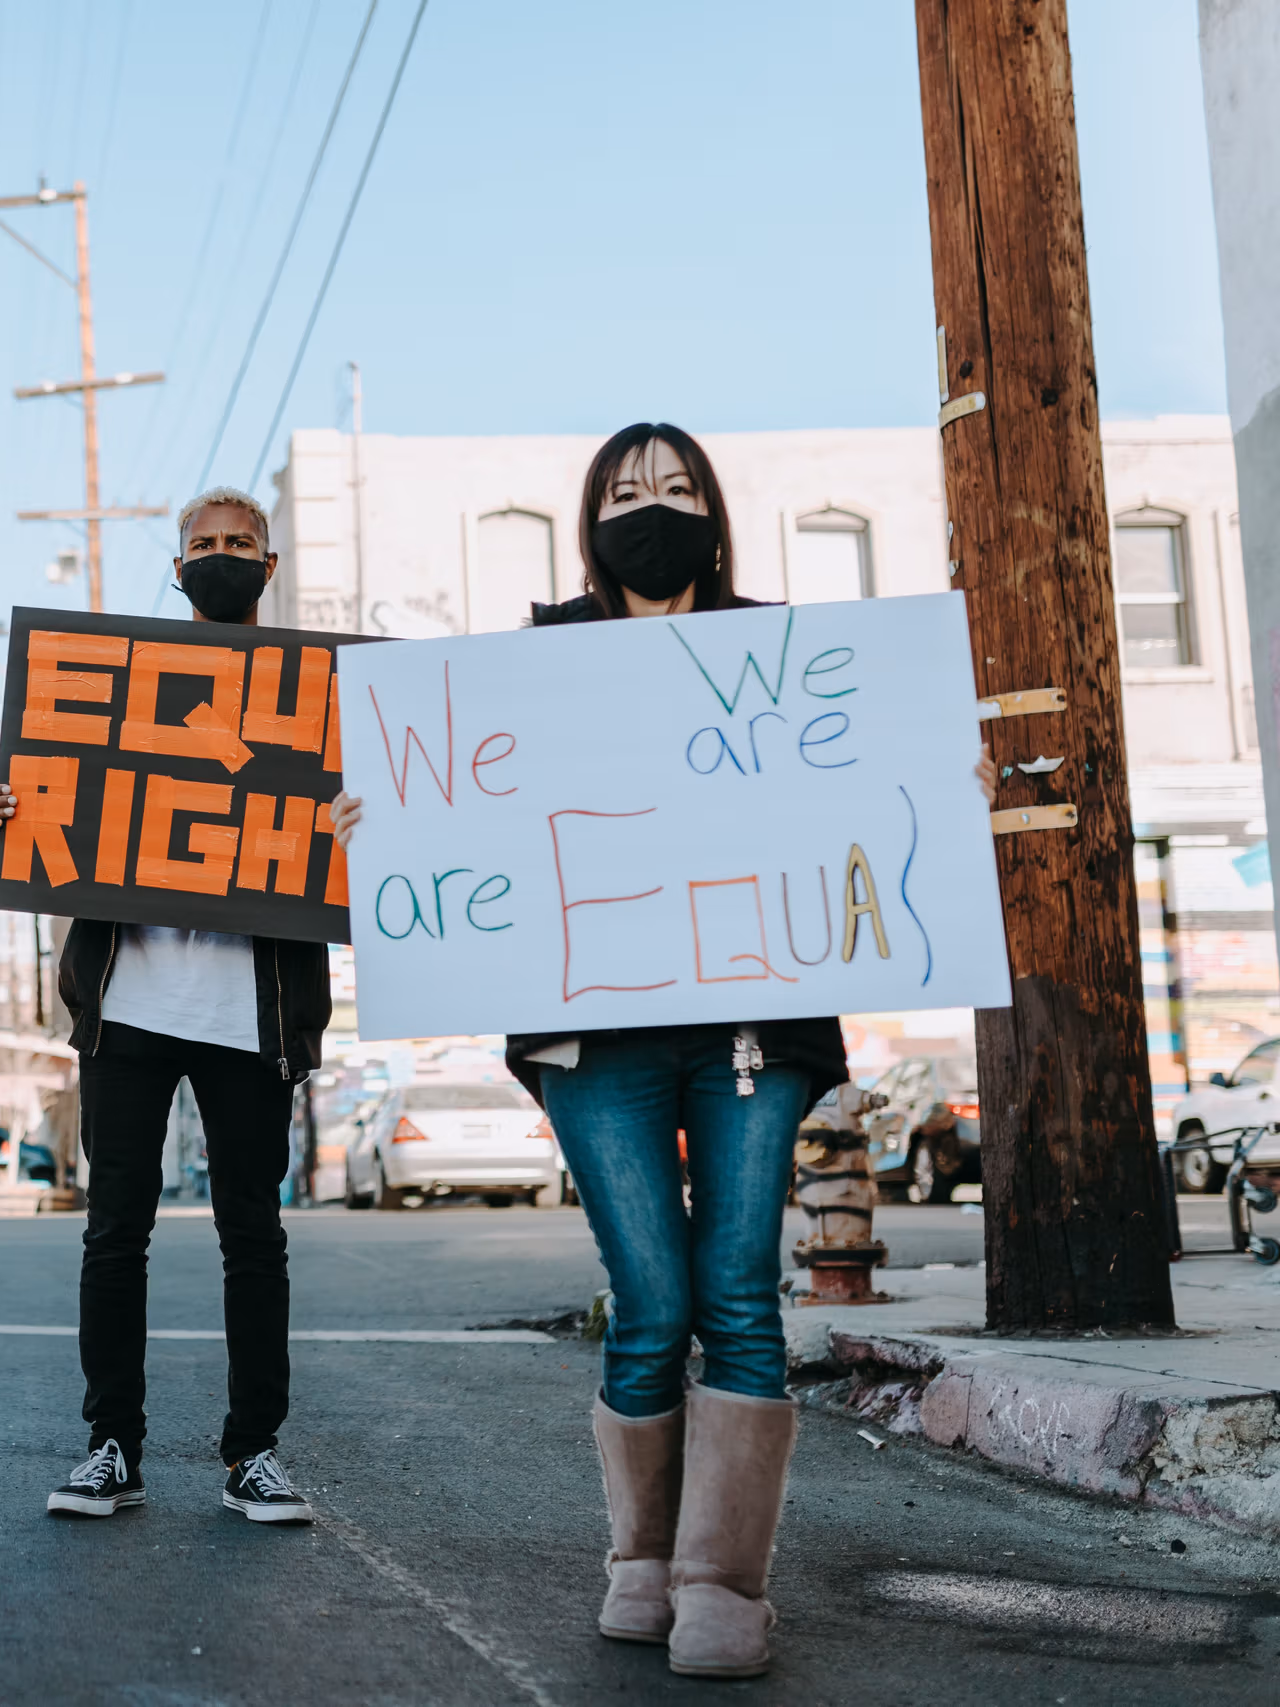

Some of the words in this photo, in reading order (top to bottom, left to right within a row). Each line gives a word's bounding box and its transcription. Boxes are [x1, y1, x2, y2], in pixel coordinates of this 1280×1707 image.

[669, 606, 860, 716] We
[368, 659, 519, 807] We
[686, 711, 860, 776] are
[375, 868, 514, 940] are
